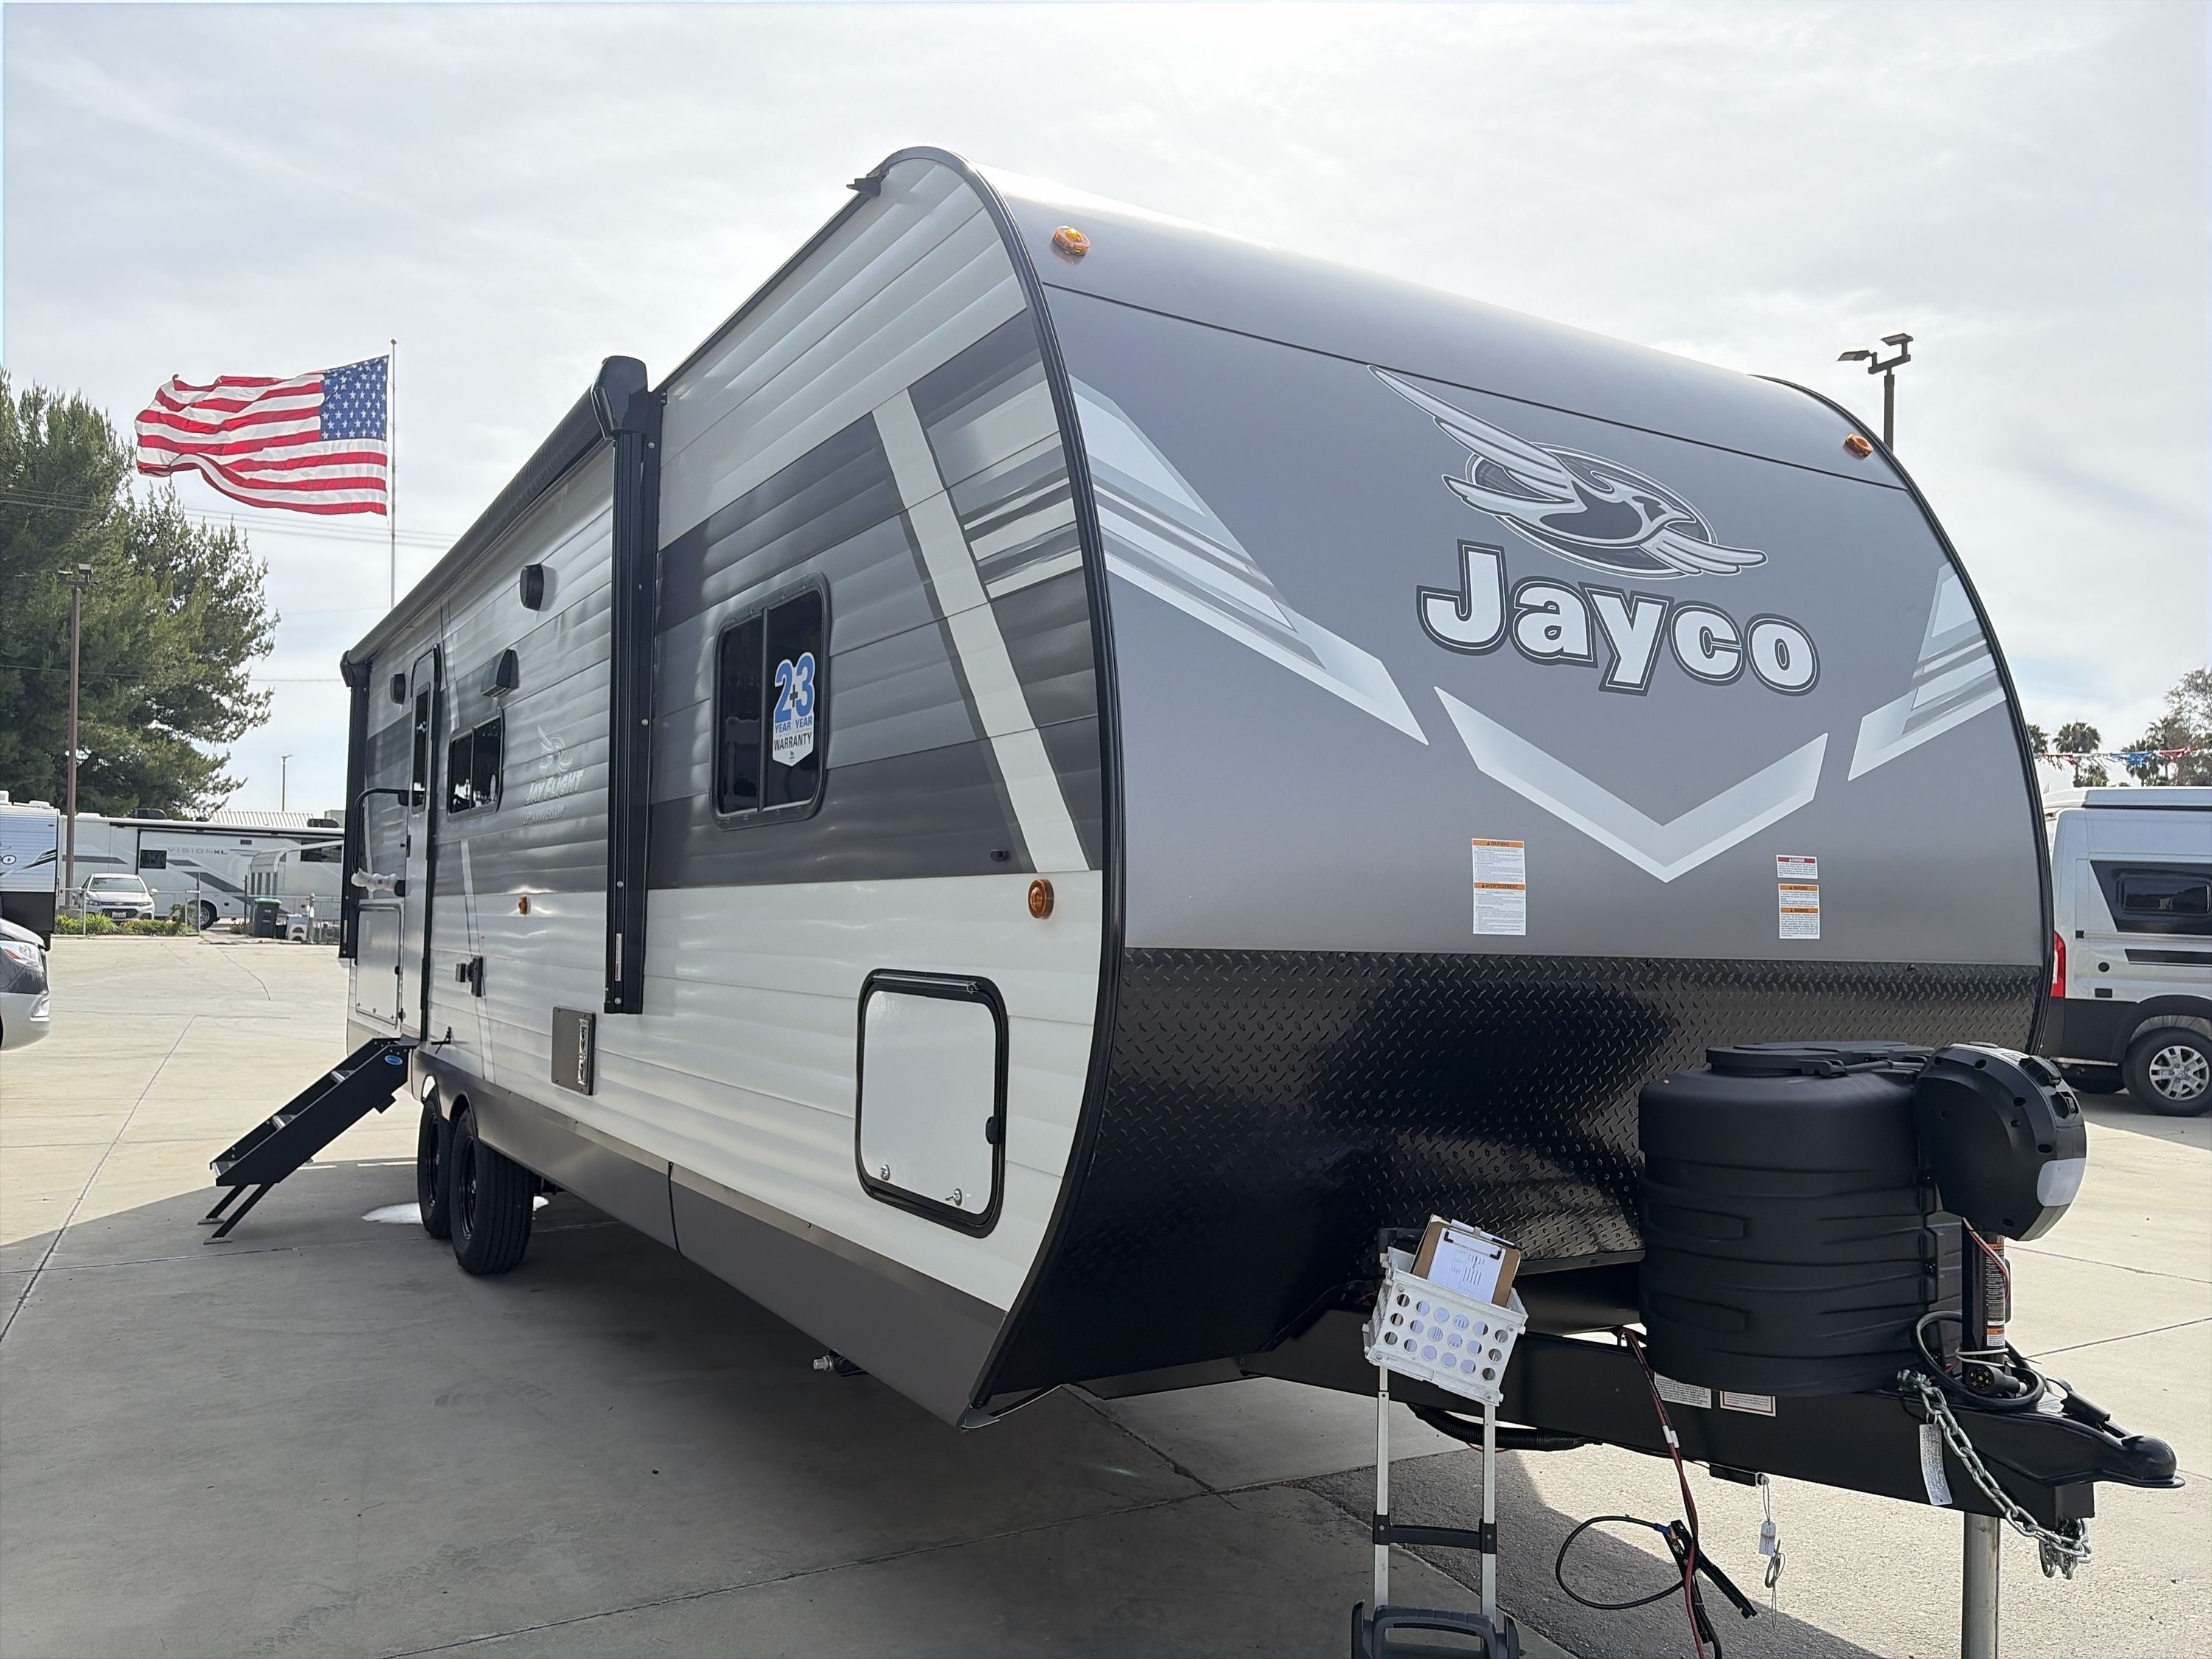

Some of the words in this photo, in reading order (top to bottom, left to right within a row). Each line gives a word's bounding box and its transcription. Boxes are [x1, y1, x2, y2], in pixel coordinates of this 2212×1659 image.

[1417, 539, 1821, 697] Jayco
[775, 722, 791, 734] YEAR
[796, 716, 813, 728] YEAR
[774, 731, 812, 751] WARRANTY
[543, 770, 584, 801] FLIGHT
